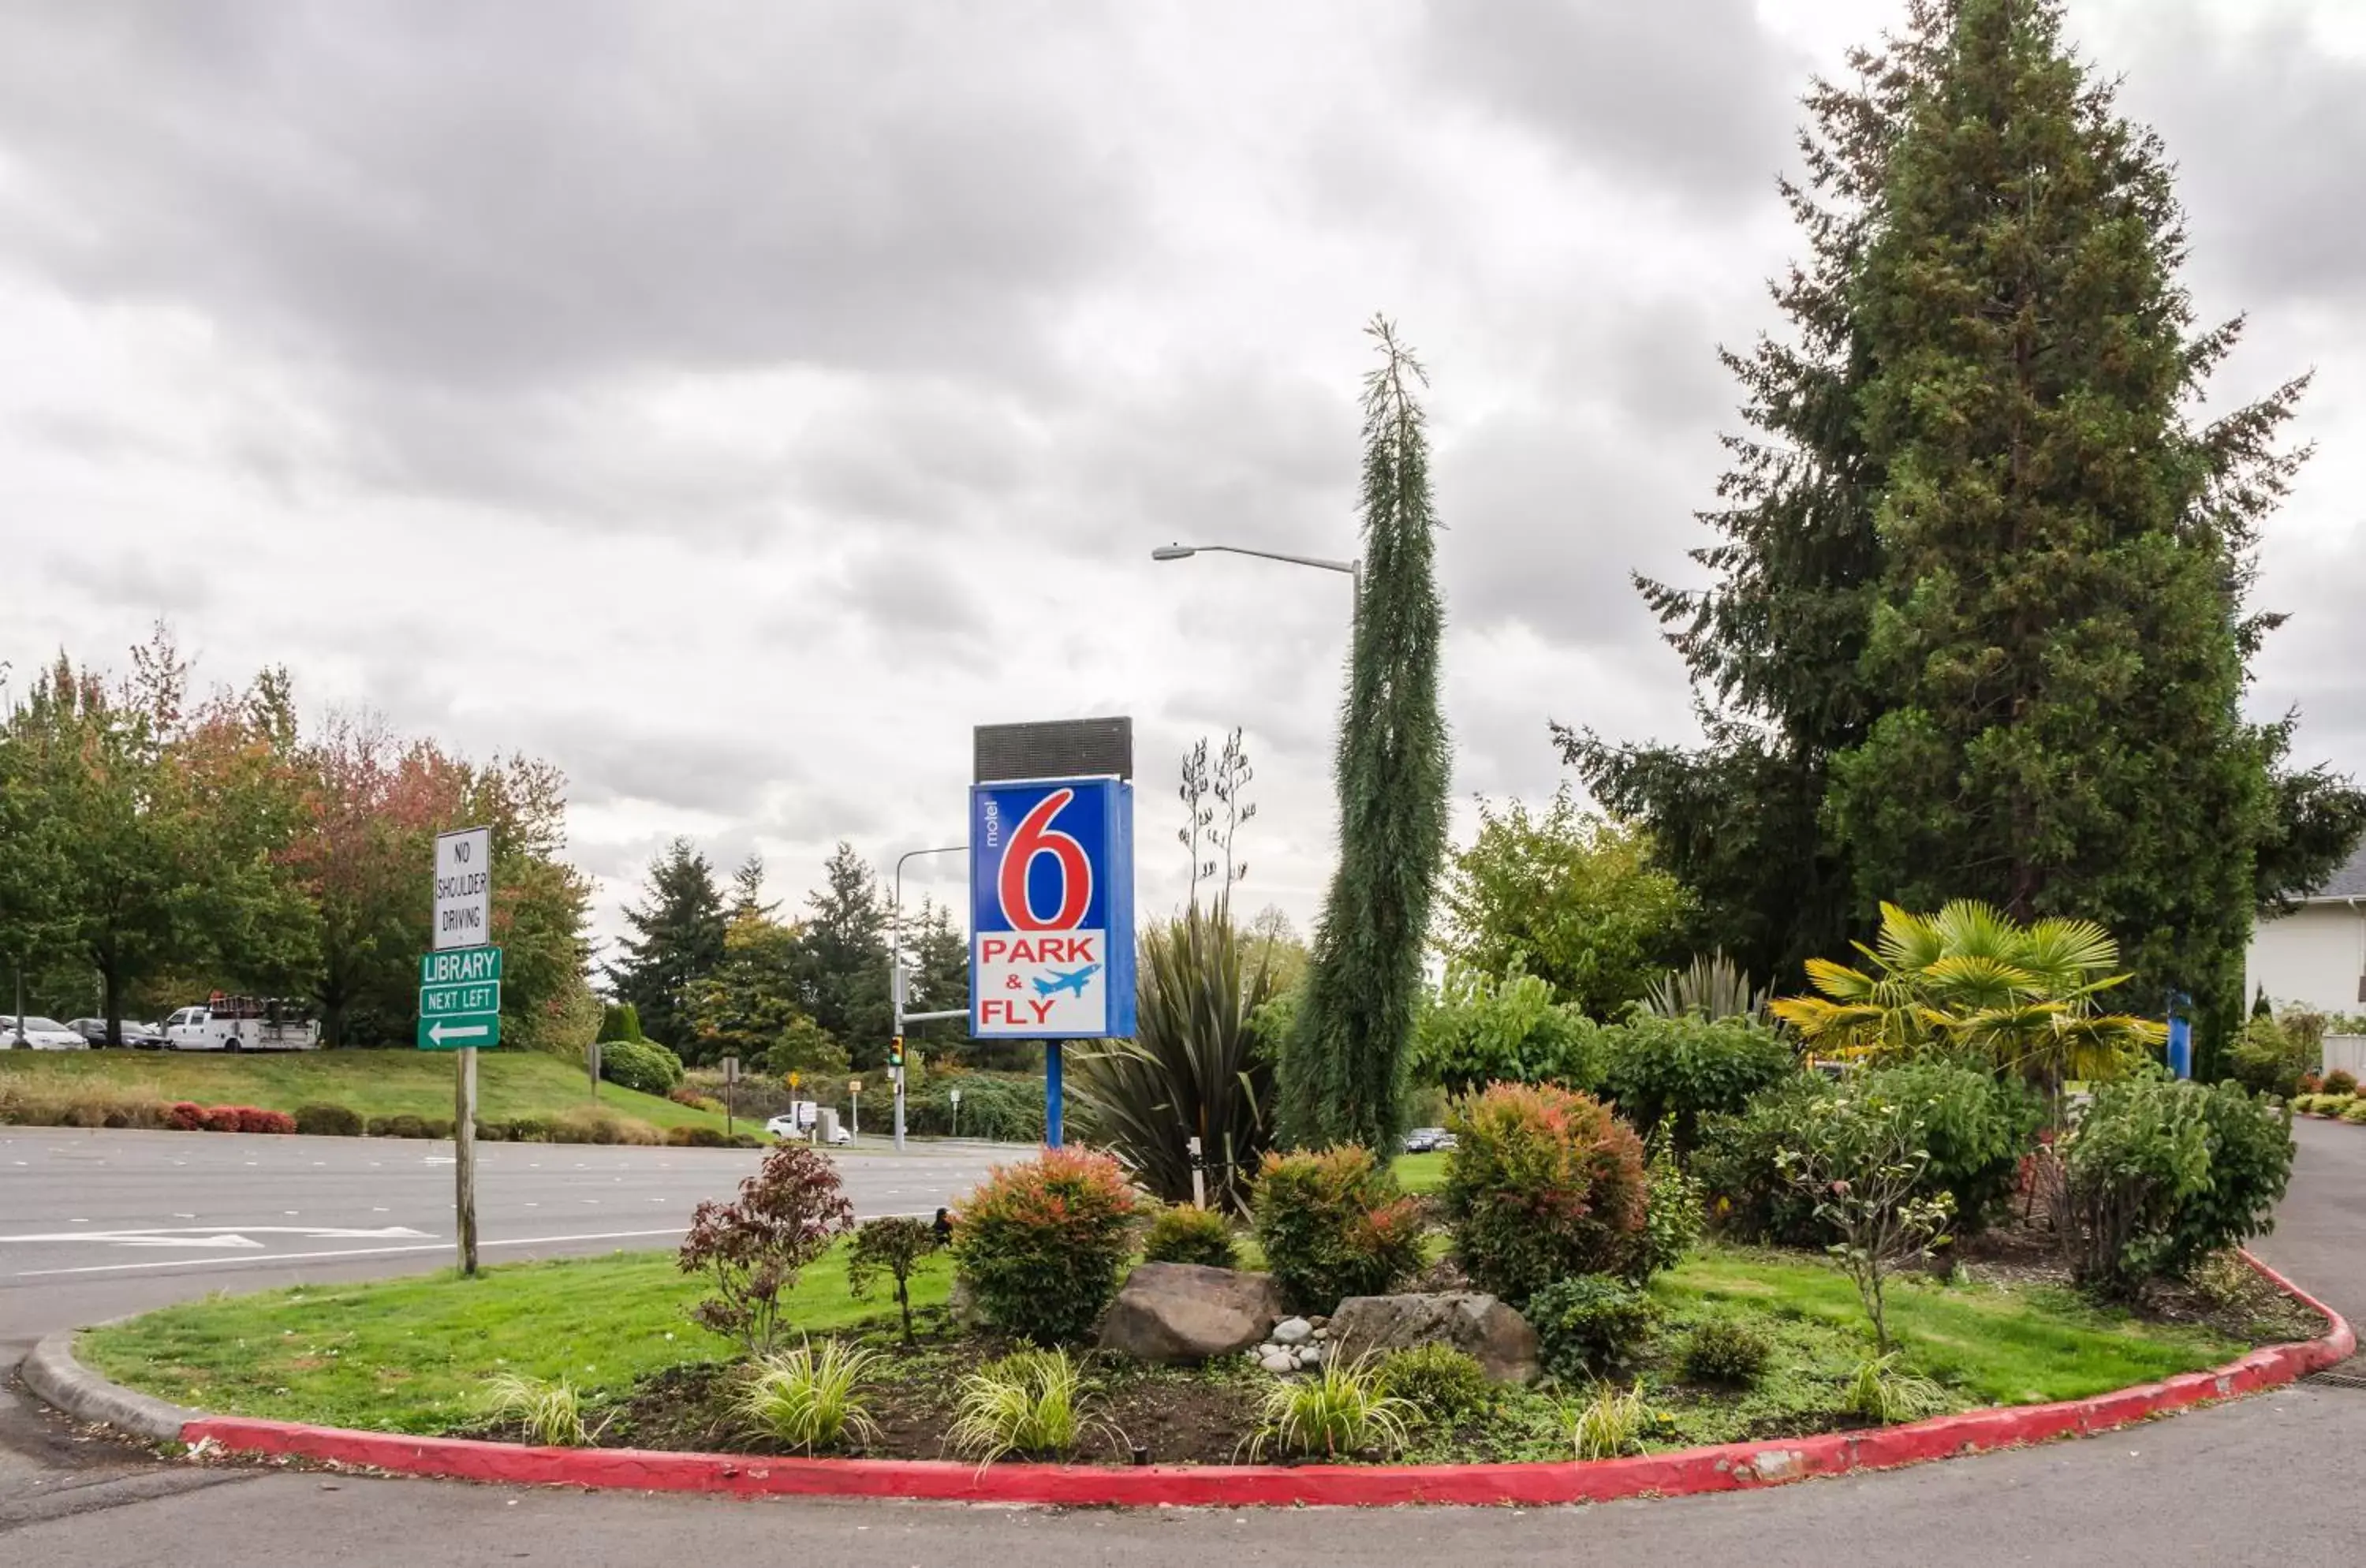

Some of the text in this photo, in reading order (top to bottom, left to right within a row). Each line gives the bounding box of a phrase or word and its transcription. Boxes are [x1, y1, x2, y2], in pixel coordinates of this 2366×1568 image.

[454, 842, 471, 864] NO
[983, 787, 1093, 931] motel 6
[437, 872, 487, 900] SHOULDER
[442, 906, 480, 931] DRIVING
[982, 937, 1095, 964] PARK
[424, 951, 496, 982] LIBRARY
[1006, 973, 1023, 990] &
[428, 988, 491, 1010] NEXT LEFT
[980, 999, 1056, 1025] FLY
